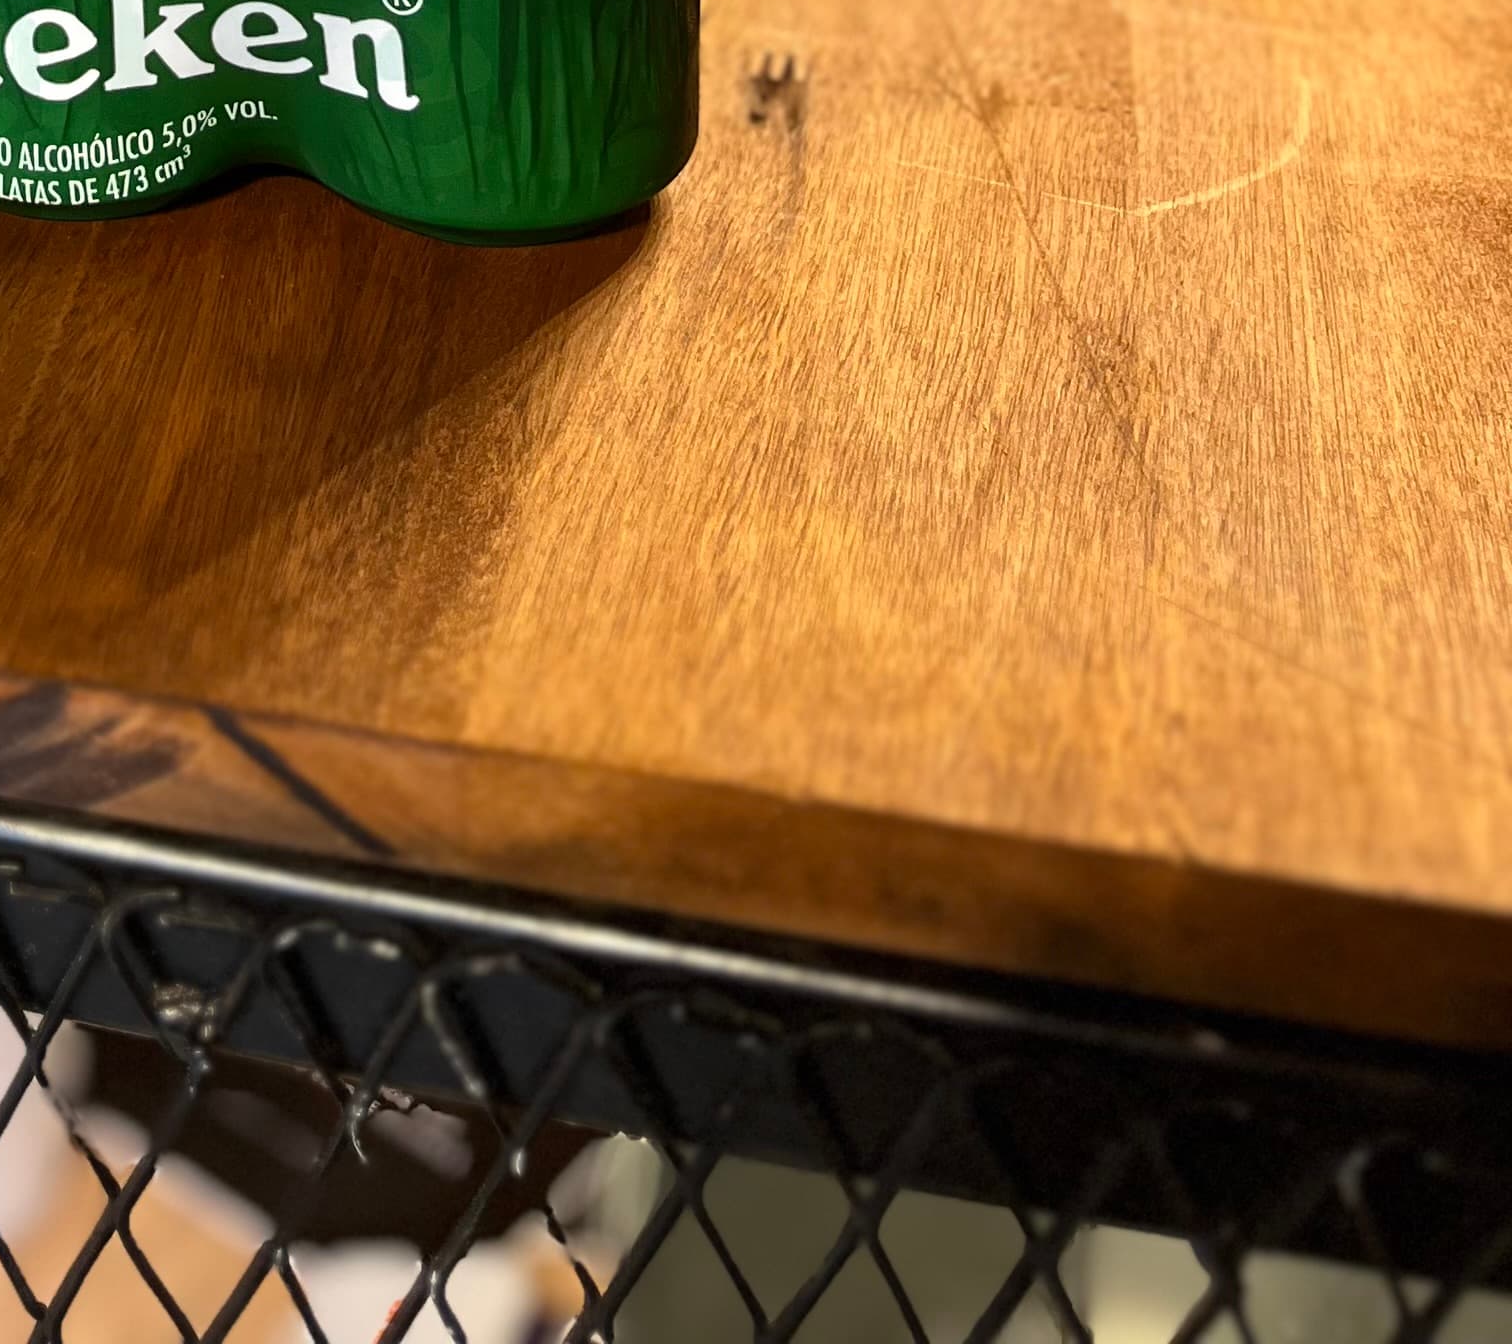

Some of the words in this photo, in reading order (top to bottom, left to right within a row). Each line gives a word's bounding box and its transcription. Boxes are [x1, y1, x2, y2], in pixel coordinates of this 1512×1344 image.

[18, 129, 155, 173] ALCOHÓLICO
[162, 107, 217, 150] 5,0%
[224, 100, 278, 120] VOL.
[69, 175, 101, 206] DE
[106, 164, 149, 201] 473
